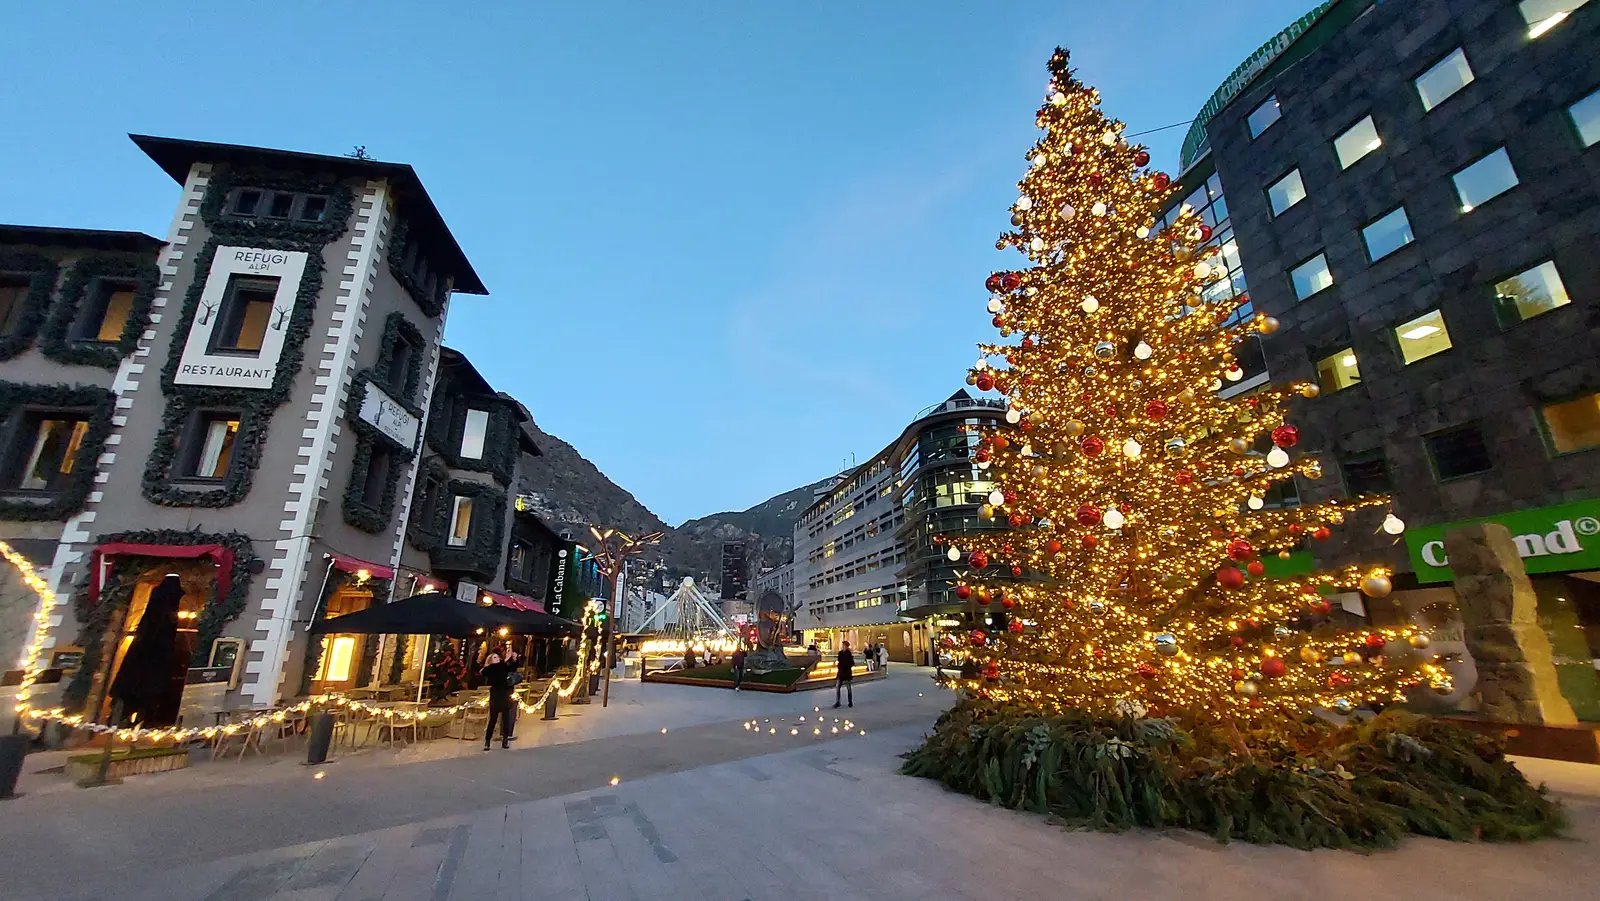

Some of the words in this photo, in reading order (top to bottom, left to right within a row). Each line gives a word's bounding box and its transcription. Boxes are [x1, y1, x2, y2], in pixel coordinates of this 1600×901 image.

[234, 251, 288, 265] REFUGI
[181, 364, 272, 379] RESTAURANT
[388, 402, 410, 426] REFUGI
[1421, 519, 1584, 567] cnd
[554, 559, 566, 593] Cabana
[553, 594, 562, 605] La
